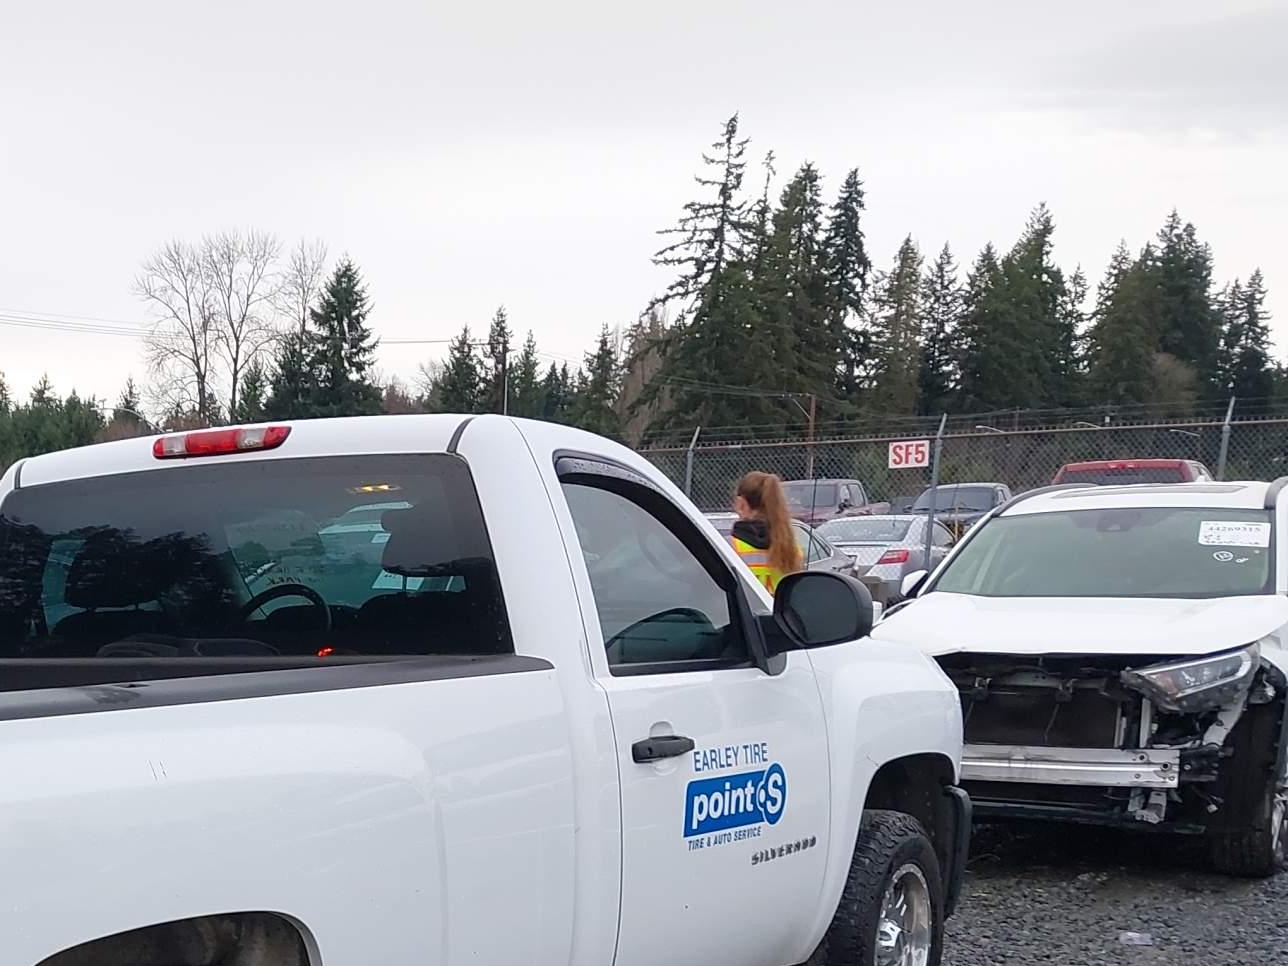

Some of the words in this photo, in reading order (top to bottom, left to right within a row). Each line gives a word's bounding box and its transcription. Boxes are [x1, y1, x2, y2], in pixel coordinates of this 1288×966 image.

[892, 443, 925, 465] SF5
[694, 746, 740, 772] EARLEY
[743, 743, 769, 764] TIRE
[692, 780, 755, 829] point
[688, 838, 705, 851] TIRE
[713, 831, 732, 846] AUTO
[734, 826, 762, 842] SERVICE
[751, 836, 817, 866] SILVERADO
